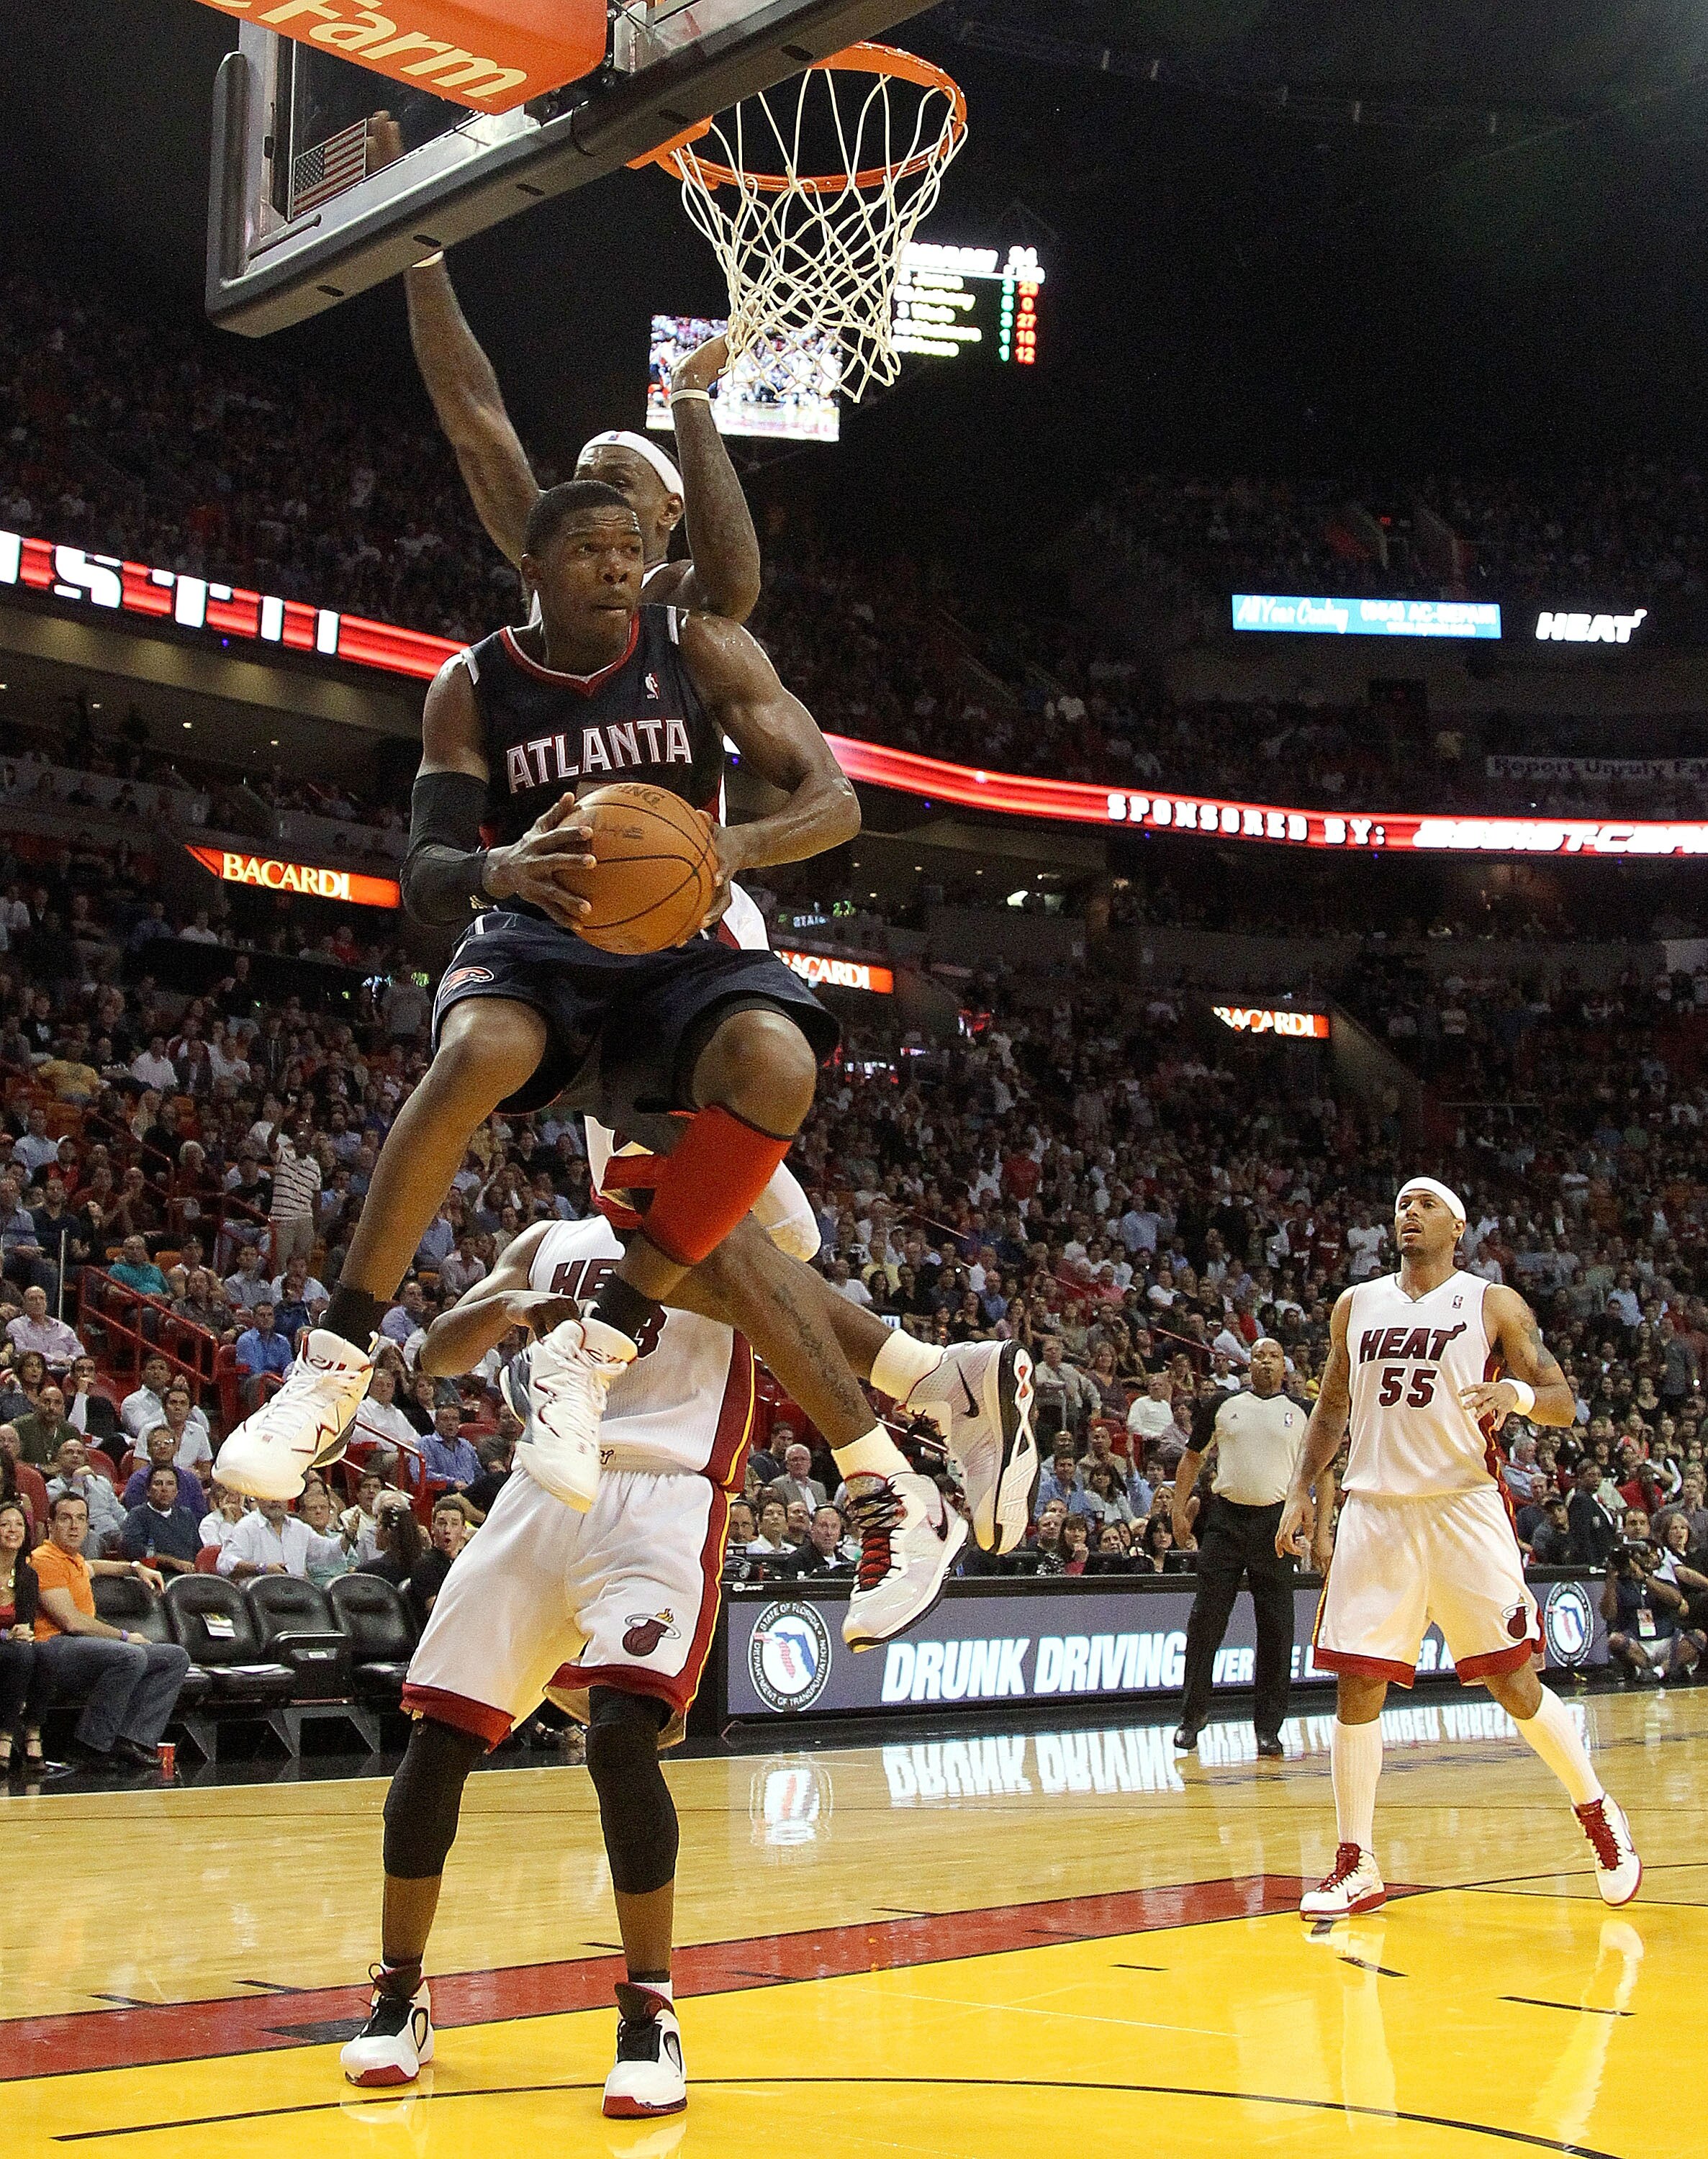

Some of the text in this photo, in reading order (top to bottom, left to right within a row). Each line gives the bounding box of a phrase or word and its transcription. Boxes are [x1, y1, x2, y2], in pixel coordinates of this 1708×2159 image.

[258, 0, 527, 98] Farm
[1016, 312, 1037, 330] 27
[1021, 297, 1034, 312] 0
[1015, 347, 1035, 365] 12
[1016, 330, 1036, 347] 10
[1535, 608, 1648, 643] HEAT
[506, 720, 692, 793] ATLANTA
[1107, 793, 1309, 841] SPONSORED
[1324, 818, 1385, 846] BY:
[222, 853, 351, 900] BACARDI
[549, 1259, 620, 1300] HE
[1360, 1321, 1467, 1364] HEAT
[1379, 1367, 1437, 1408] 55
[881, 1637, 1030, 1702] DRUNK
[1034, 1631, 1187, 1693] DRIVING
[1211, 1647, 1255, 1684] VER
